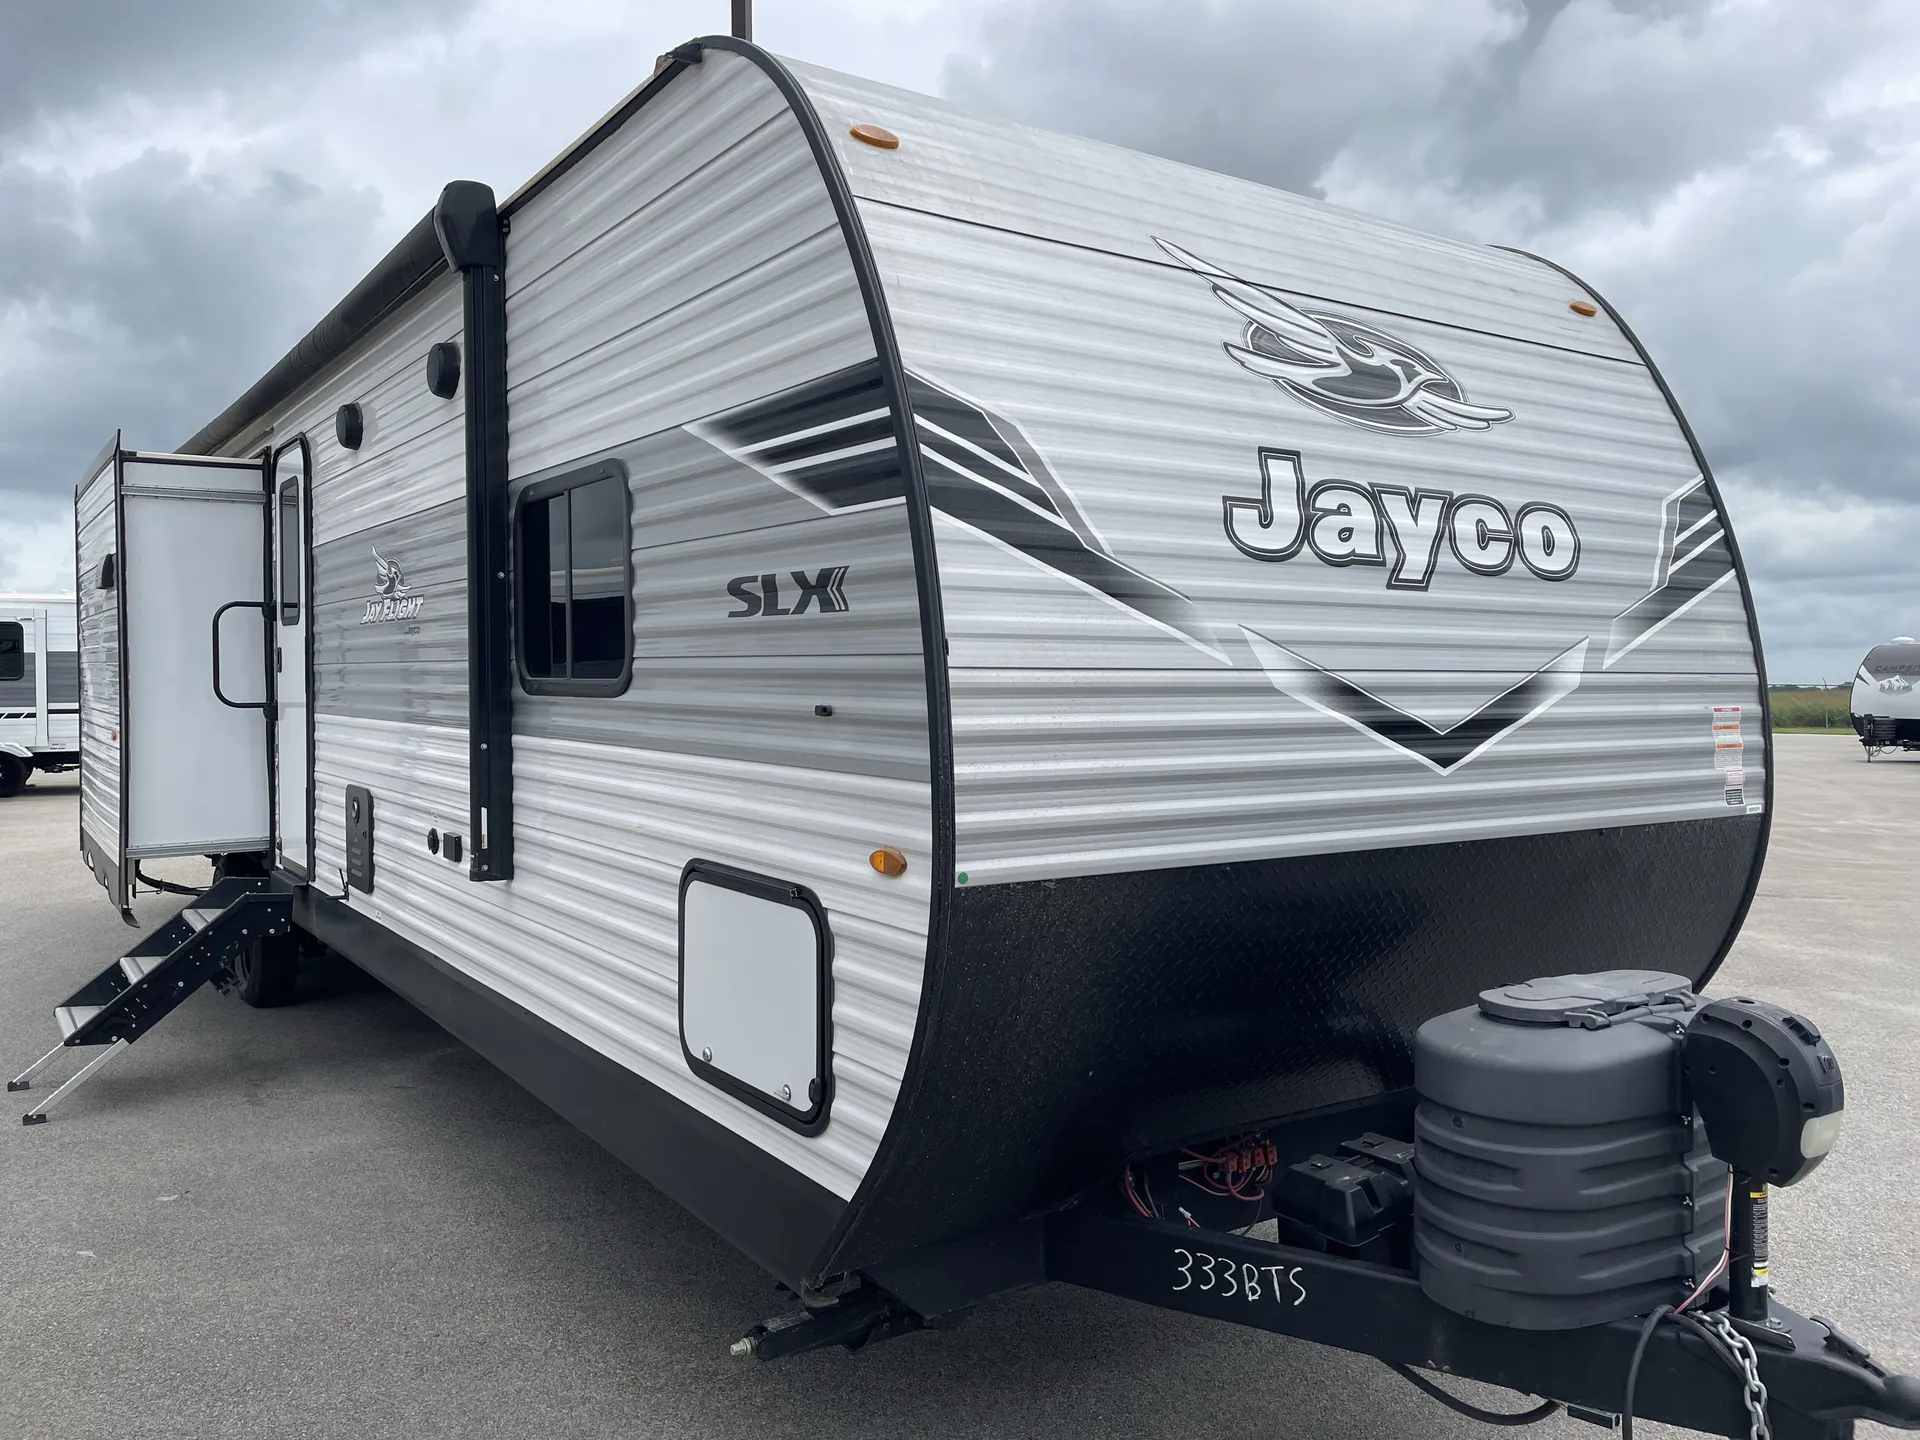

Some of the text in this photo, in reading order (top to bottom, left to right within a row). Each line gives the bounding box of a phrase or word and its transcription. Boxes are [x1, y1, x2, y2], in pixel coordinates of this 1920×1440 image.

[1222, 445, 1581, 592] Jayco
[360, 594, 424, 625] JAY FLIGHT
[727, 565, 850, 618] SLX
[1173, 1248, 1306, 1306] 333BTS
